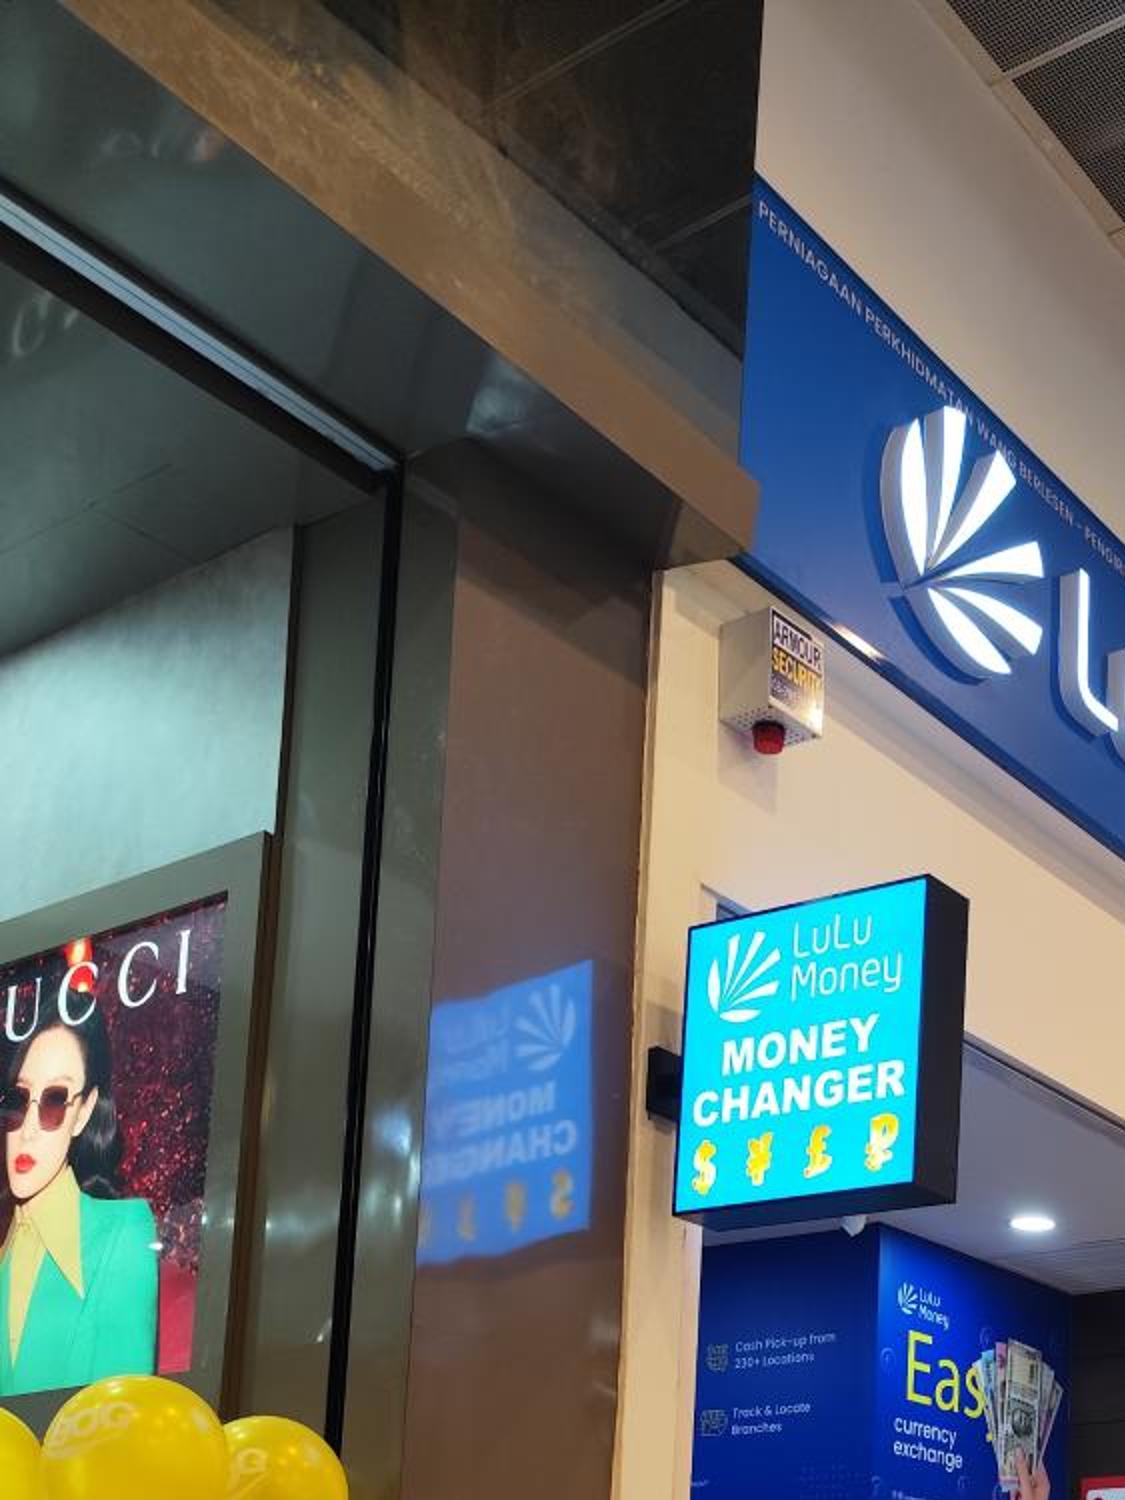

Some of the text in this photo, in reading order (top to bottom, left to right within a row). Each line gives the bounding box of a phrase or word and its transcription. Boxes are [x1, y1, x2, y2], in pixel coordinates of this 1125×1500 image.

[759, 201, 862, 316] PERNIAGAAN
[865, 308, 973, 426] PERKHIDMATAN
[774, 617, 823, 676] ARMOUR
[772, 647, 823, 694] SECURITY
[790, 951, 903, 1002] Money
[721, 1013, 880, 1076] MONEY
[692, 1059, 905, 1128] CHANGER
[735, 1340, 763, 1352] Cash
[809, 1333, 836, 1344] from
[762, 1351, 815, 1367] Locations
[906, 1330, 993, 1441] Eas
[731, 1422, 782, 1435] Branches
[733, 1403, 811, 1418] Track & Locate
[894, 1416, 957, 1449] currency
[893, 1439, 963, 1472] exchange
